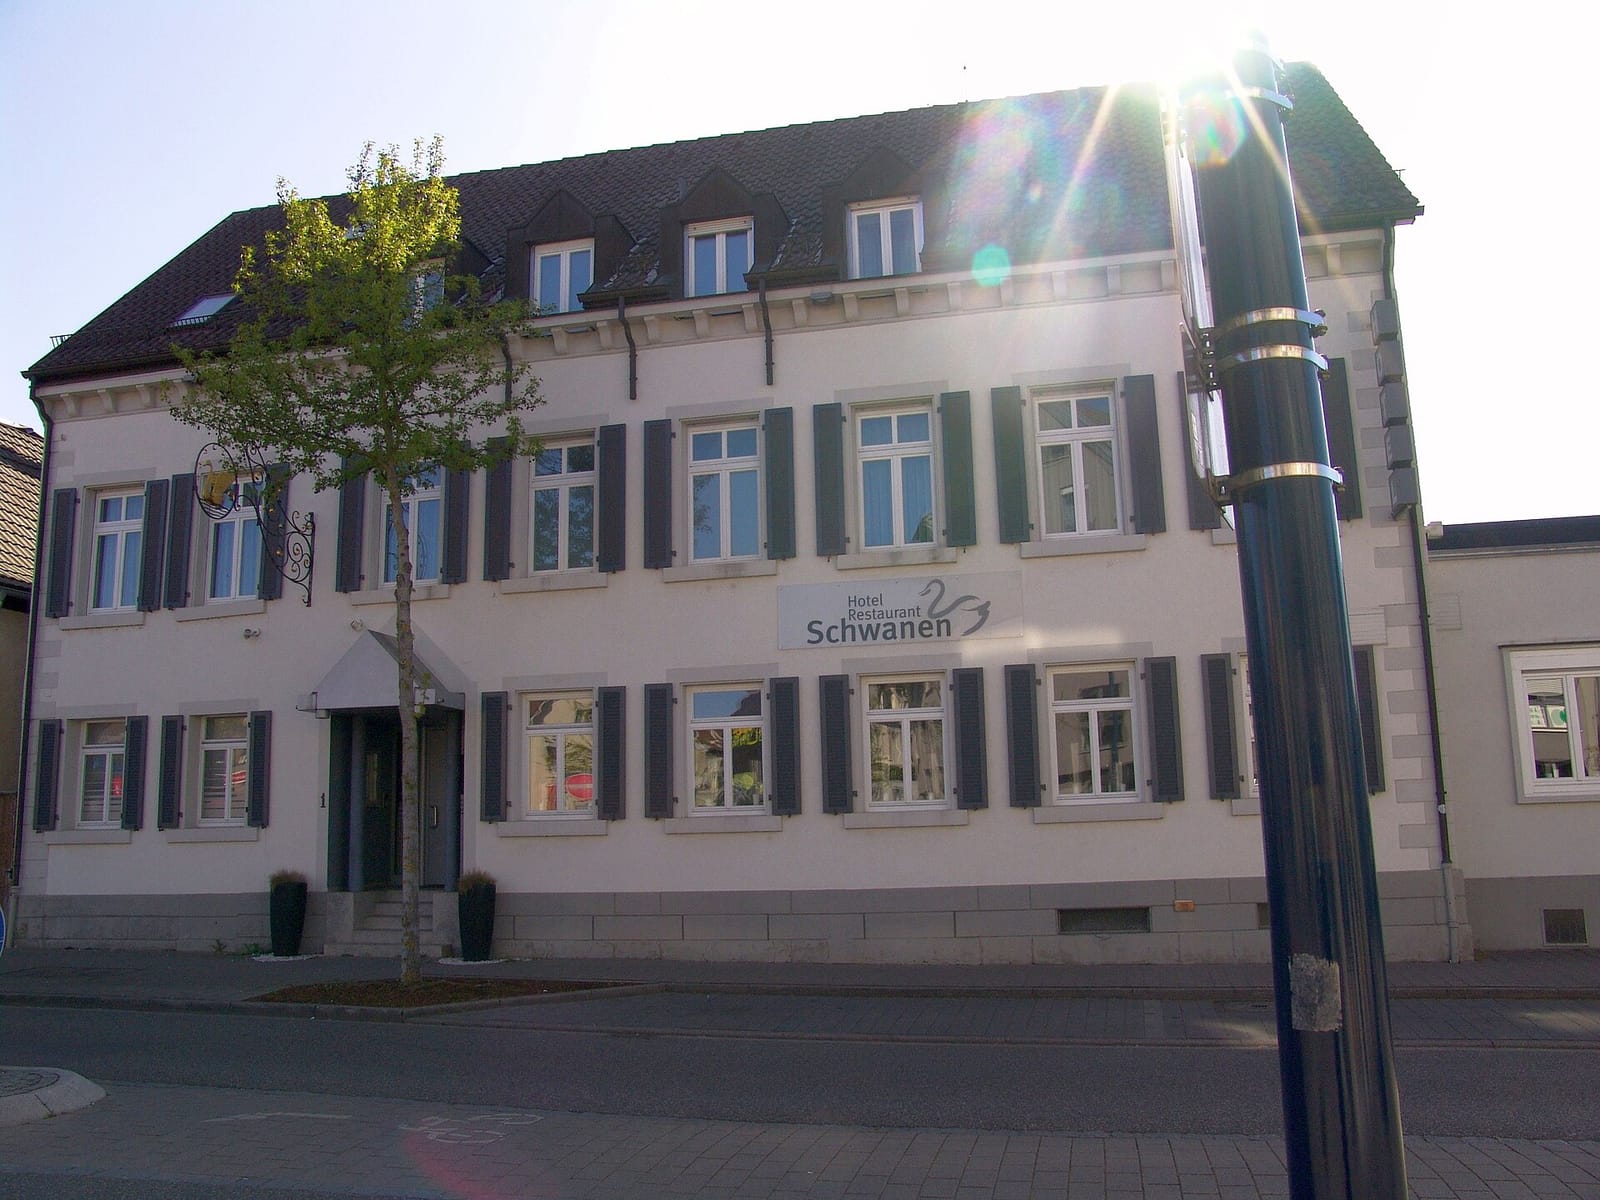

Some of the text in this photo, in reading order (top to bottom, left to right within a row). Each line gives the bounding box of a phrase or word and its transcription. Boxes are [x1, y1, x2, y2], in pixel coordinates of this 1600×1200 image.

[848, 593, 883, 607] Hotel
[848, 605, 921, 620] Restaurant
[807, 617, 951, 644] Schwanen
